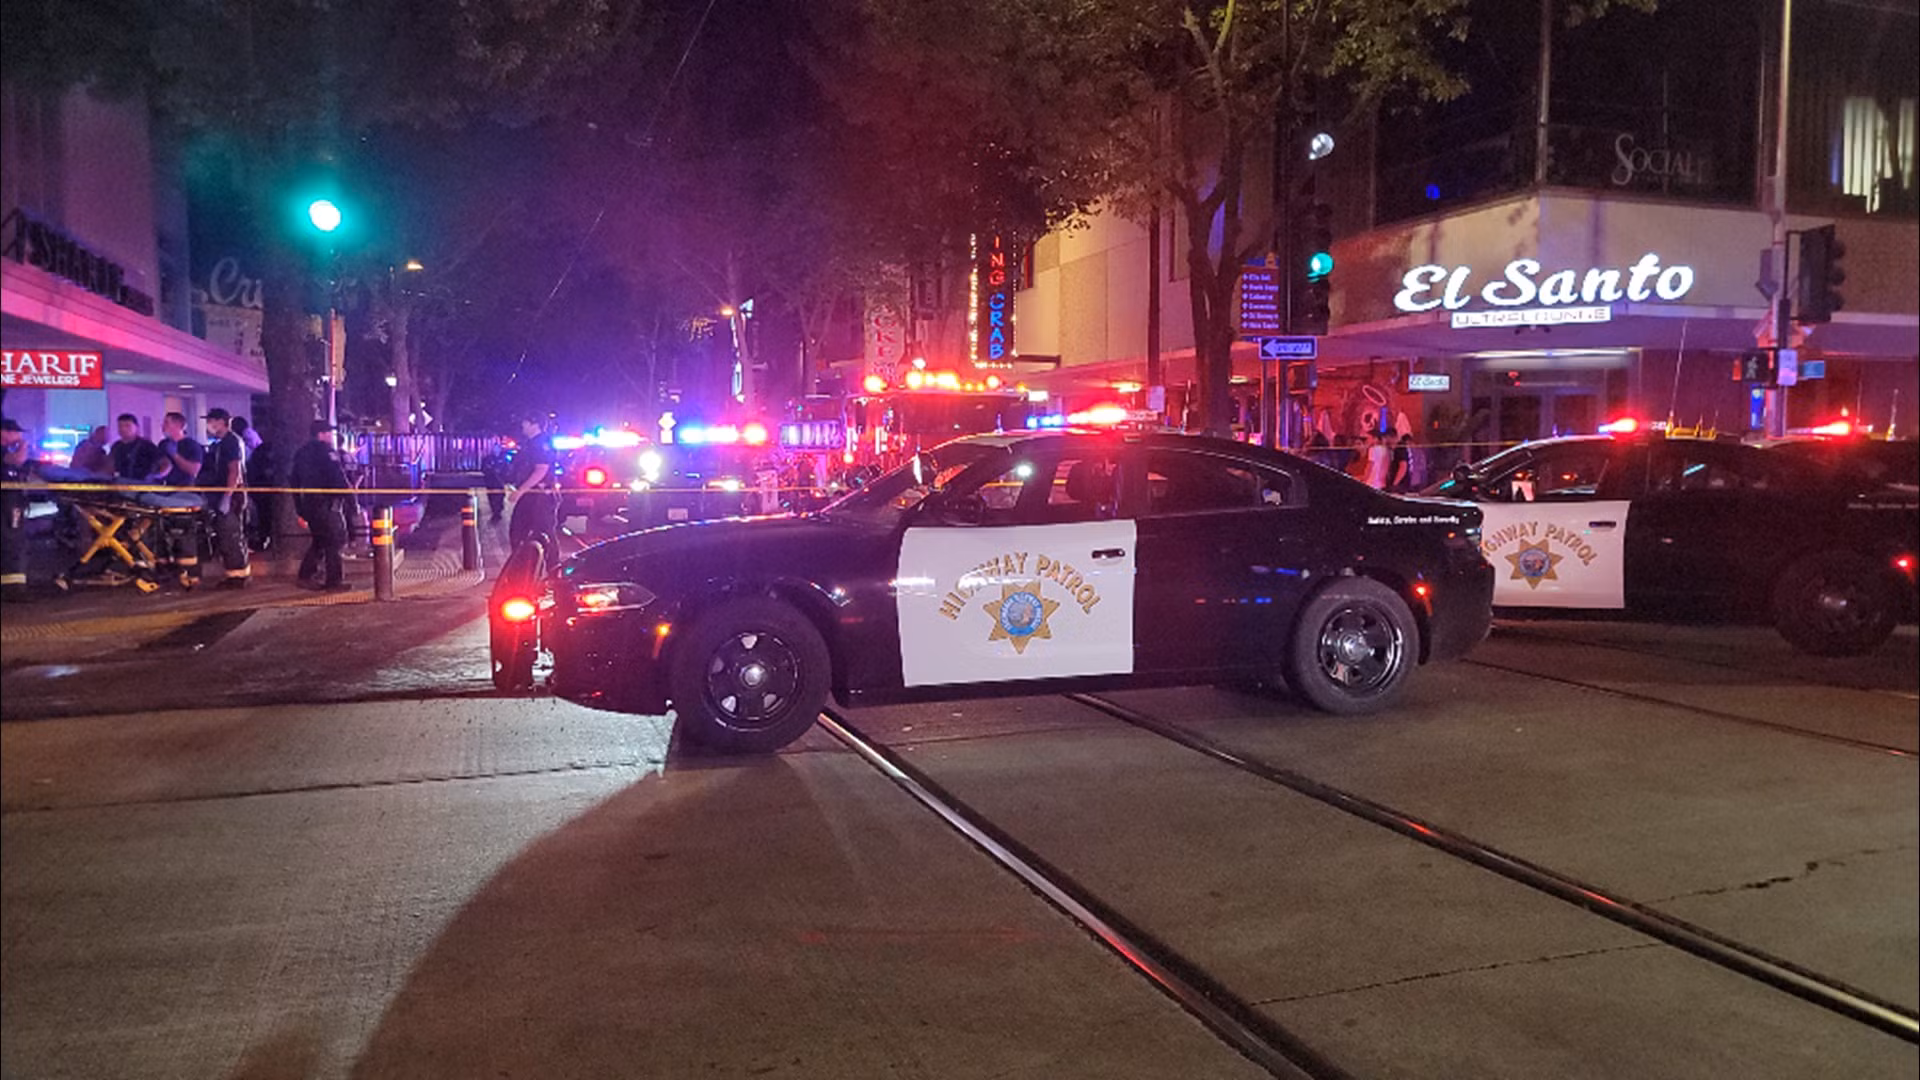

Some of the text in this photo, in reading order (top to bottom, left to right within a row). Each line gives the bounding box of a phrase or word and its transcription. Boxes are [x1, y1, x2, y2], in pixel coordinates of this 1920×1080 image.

[1394, 253, 1694, 312] El Santo
[989, 293, 1005, 360] CRAB
[1545, 523, 1597, 566] PATROL
[1036, 554, 1101, 615] PATROL
